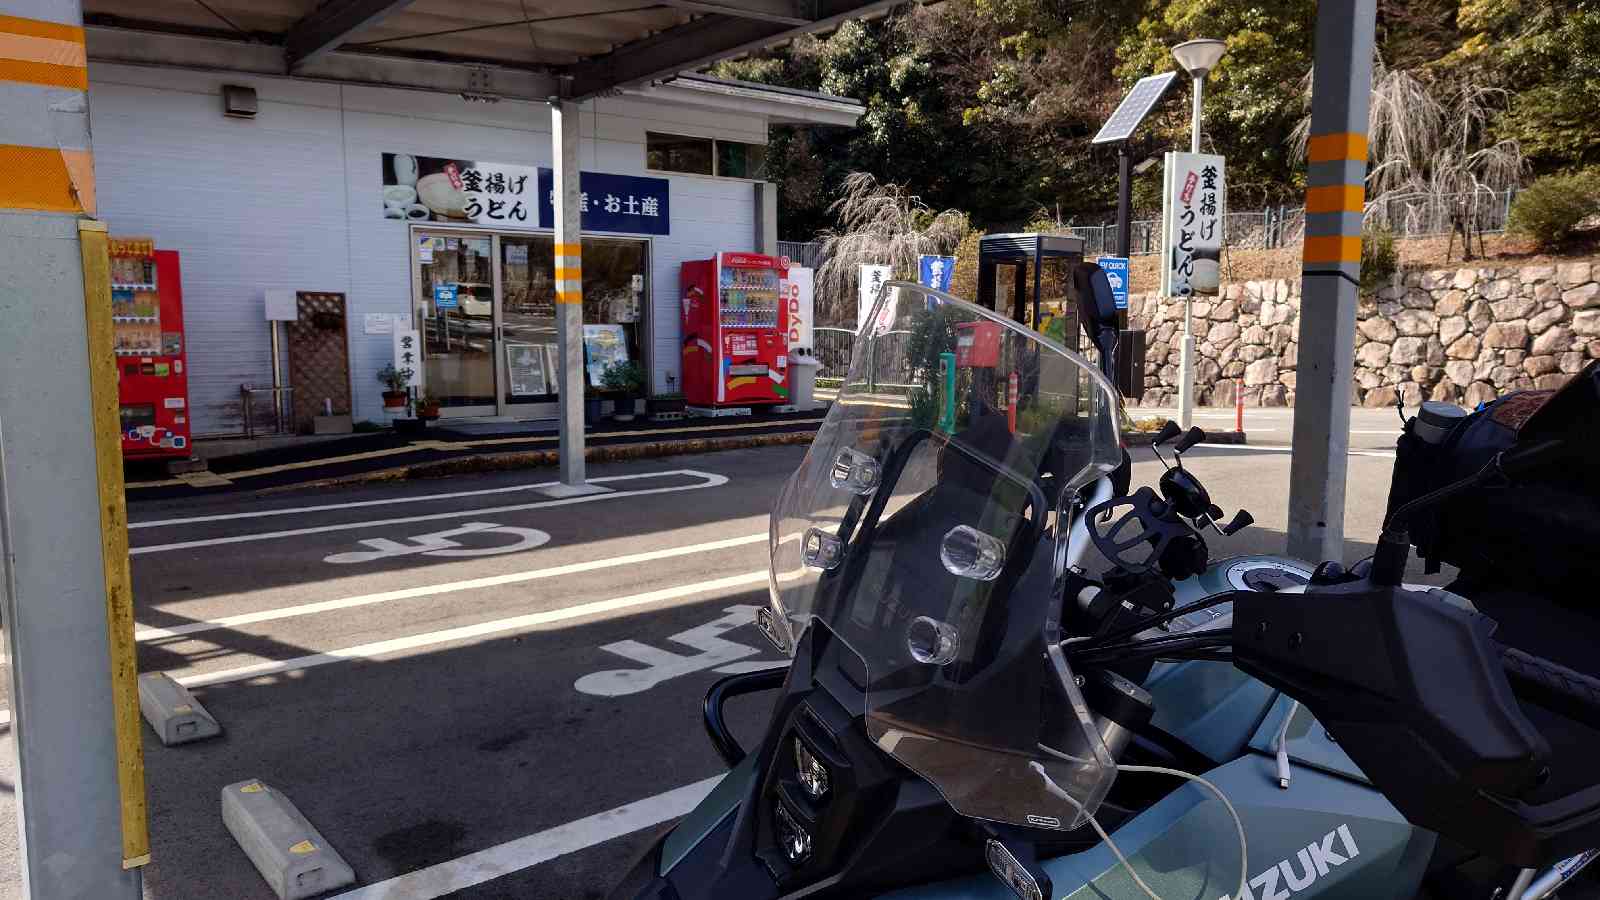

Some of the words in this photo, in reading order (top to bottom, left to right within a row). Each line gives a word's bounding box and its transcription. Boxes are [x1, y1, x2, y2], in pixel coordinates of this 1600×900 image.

[461, 169, 528, 195] 釜揚げ
[464, 197, 527, 221] うどん
[549, 189, 659, 217] 産・お土産
[1199, 164, 1218, 241] 釜揚げ
[1177, 206, 1196, 277] うどん
[1108, 262, 1126, 270] QUICK
[788, 284, 802, 343] DyDo
